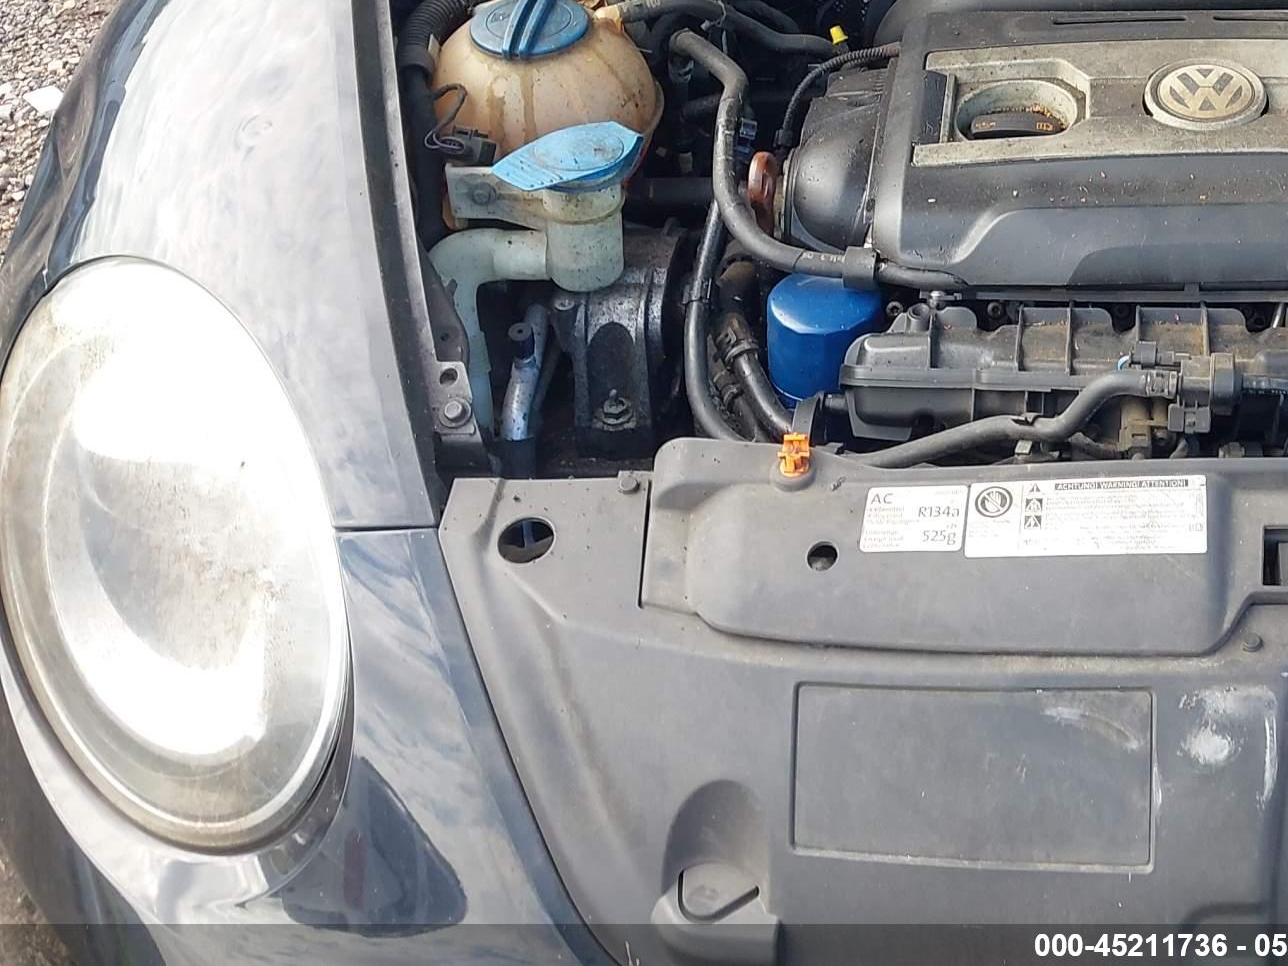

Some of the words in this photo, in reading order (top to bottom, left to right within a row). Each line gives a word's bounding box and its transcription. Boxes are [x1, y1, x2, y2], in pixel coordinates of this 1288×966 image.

[1158, 63, 1254, 119] VW
[870, 493, 894, 504] AC
[918, 505, 960, 518] R134a
[922, 529, 957, 546] 525g
